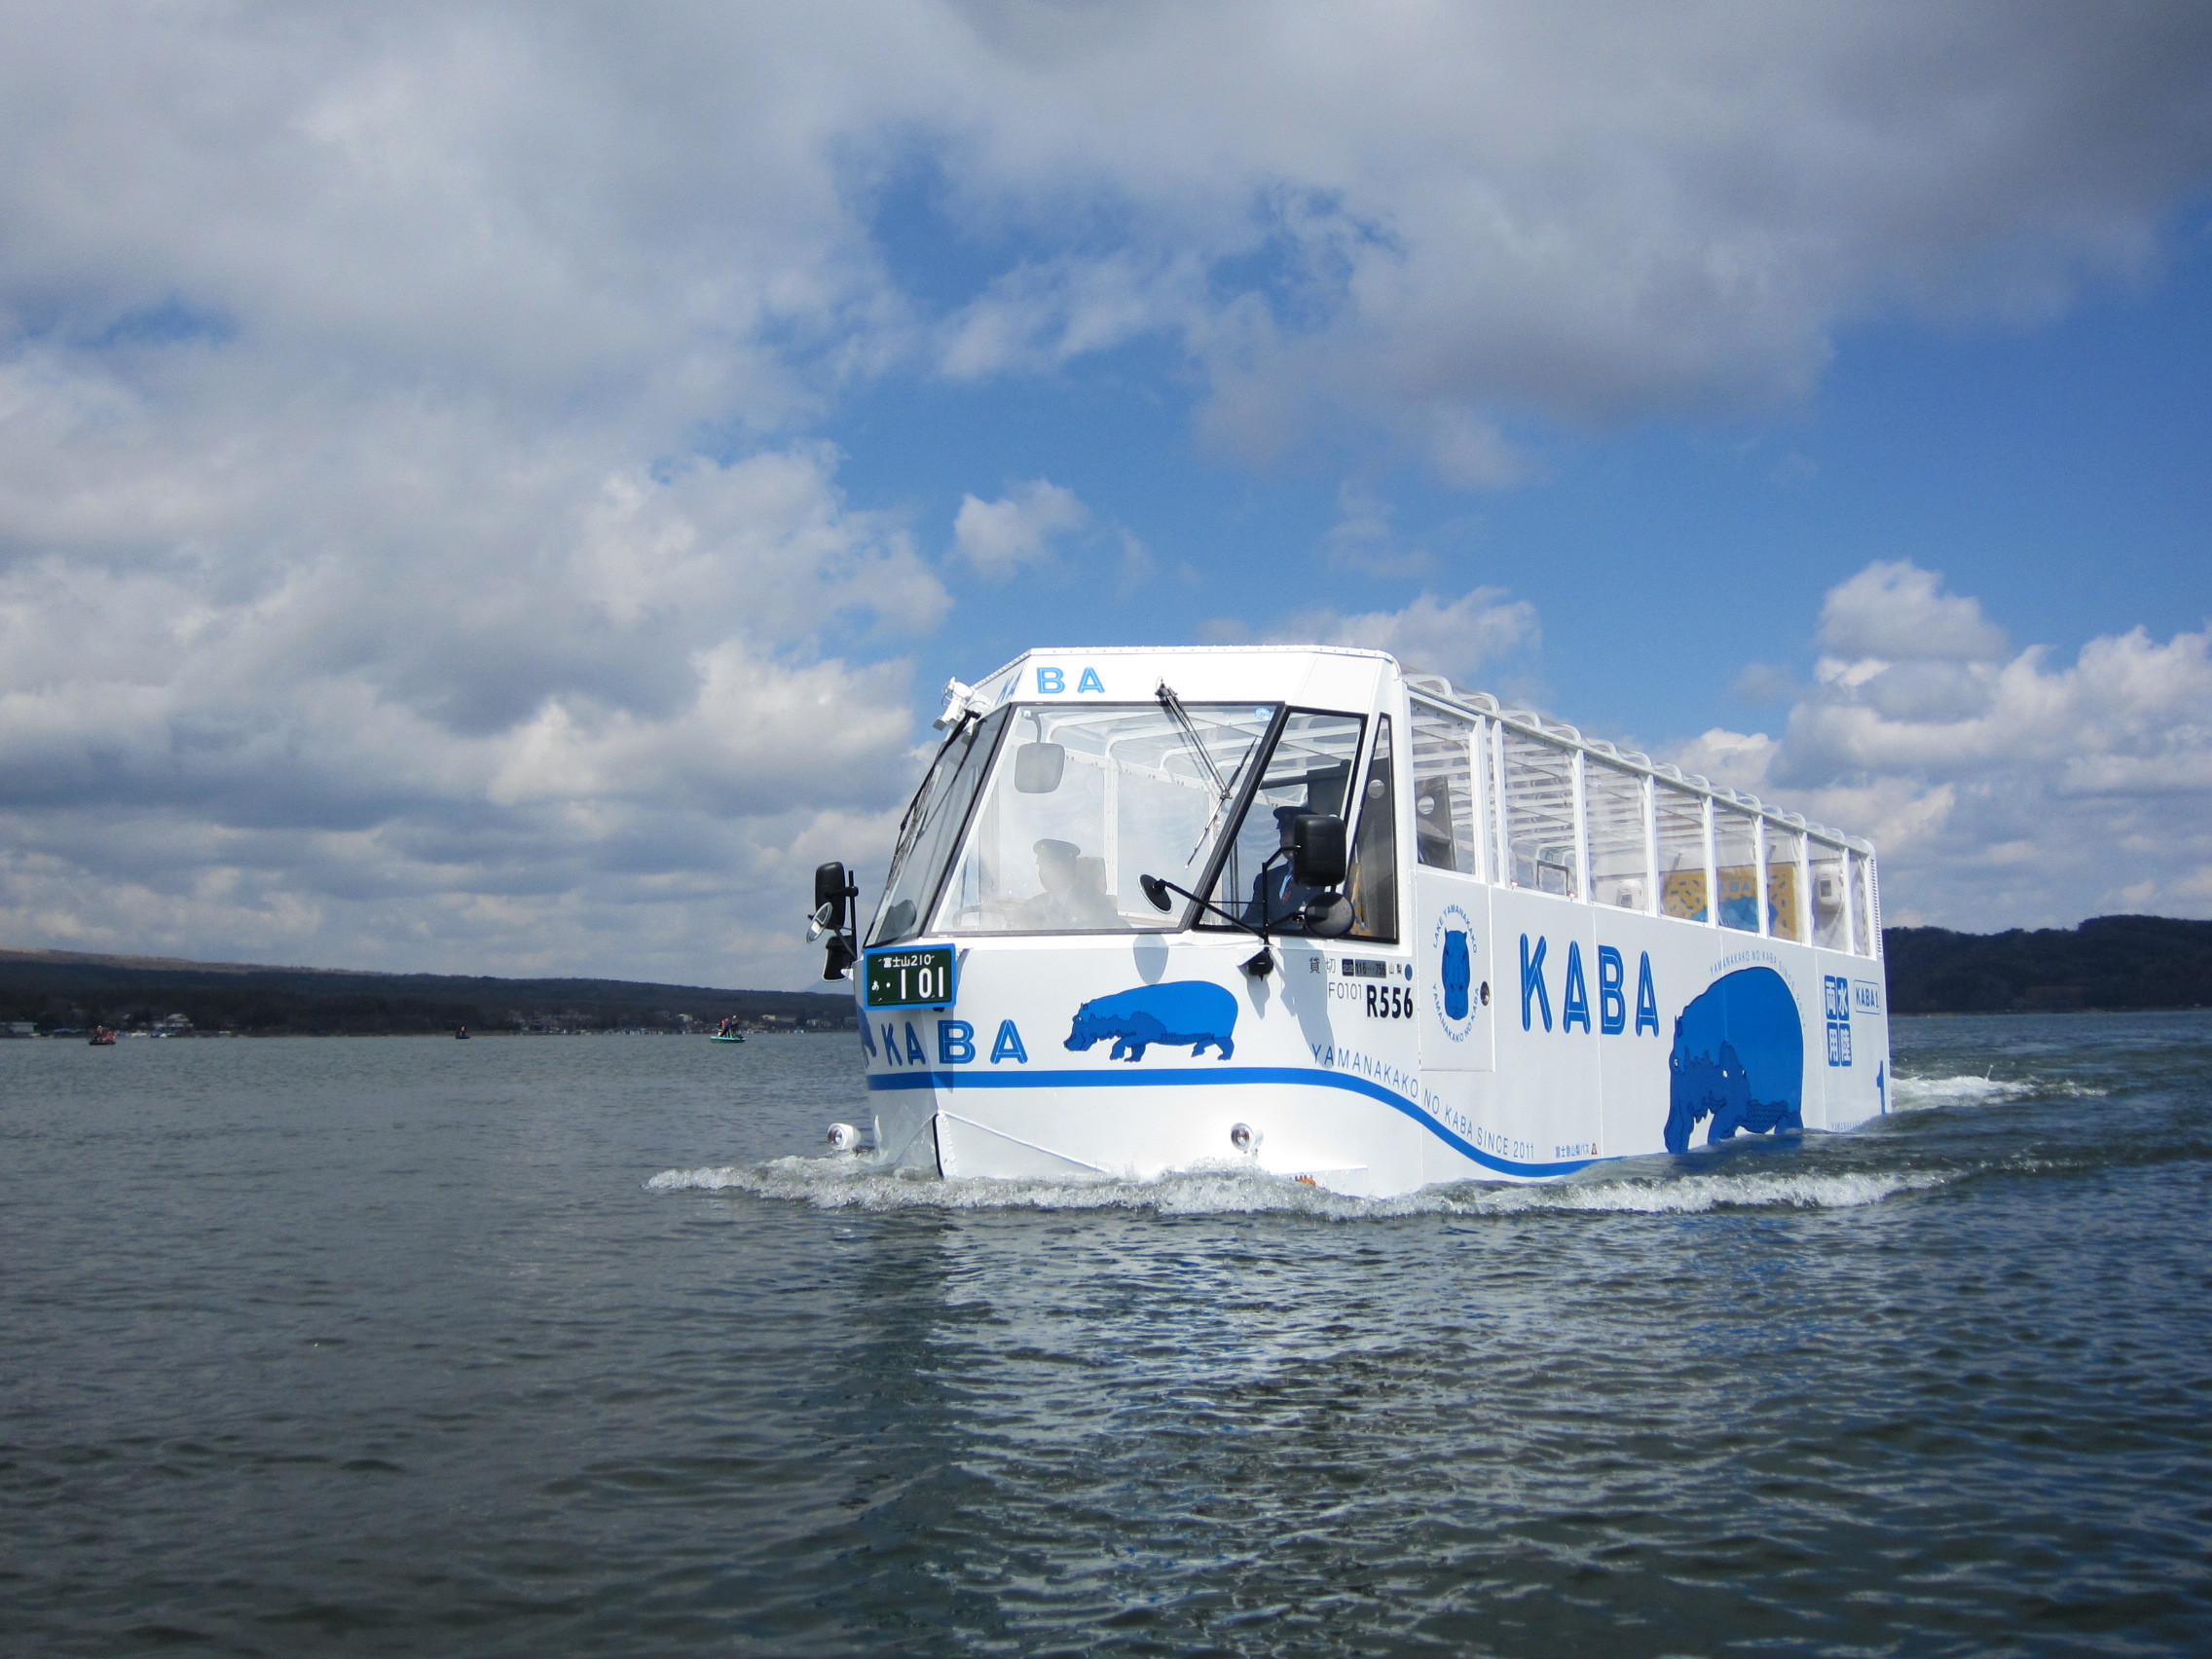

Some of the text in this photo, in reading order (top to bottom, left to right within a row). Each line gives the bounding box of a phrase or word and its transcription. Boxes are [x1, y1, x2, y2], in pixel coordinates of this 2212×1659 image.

[1433, 904, 1478, 953] LAKE YAMANAKAKO
[1752, 950, 1760, 961] NO
[1366, 984, 1414, 1019] R556
[1520, 933, 1660, 1037] KABA
[1433, 983, 1464, 1043] YAMANAKAKO
[1464, 1022, 1472, 1038] NO
[881, 1018, 1028, 1067] KABA
[1311, 1043, 1534, 1160] YAMANAKAKO NO KABA SINCE 2011
